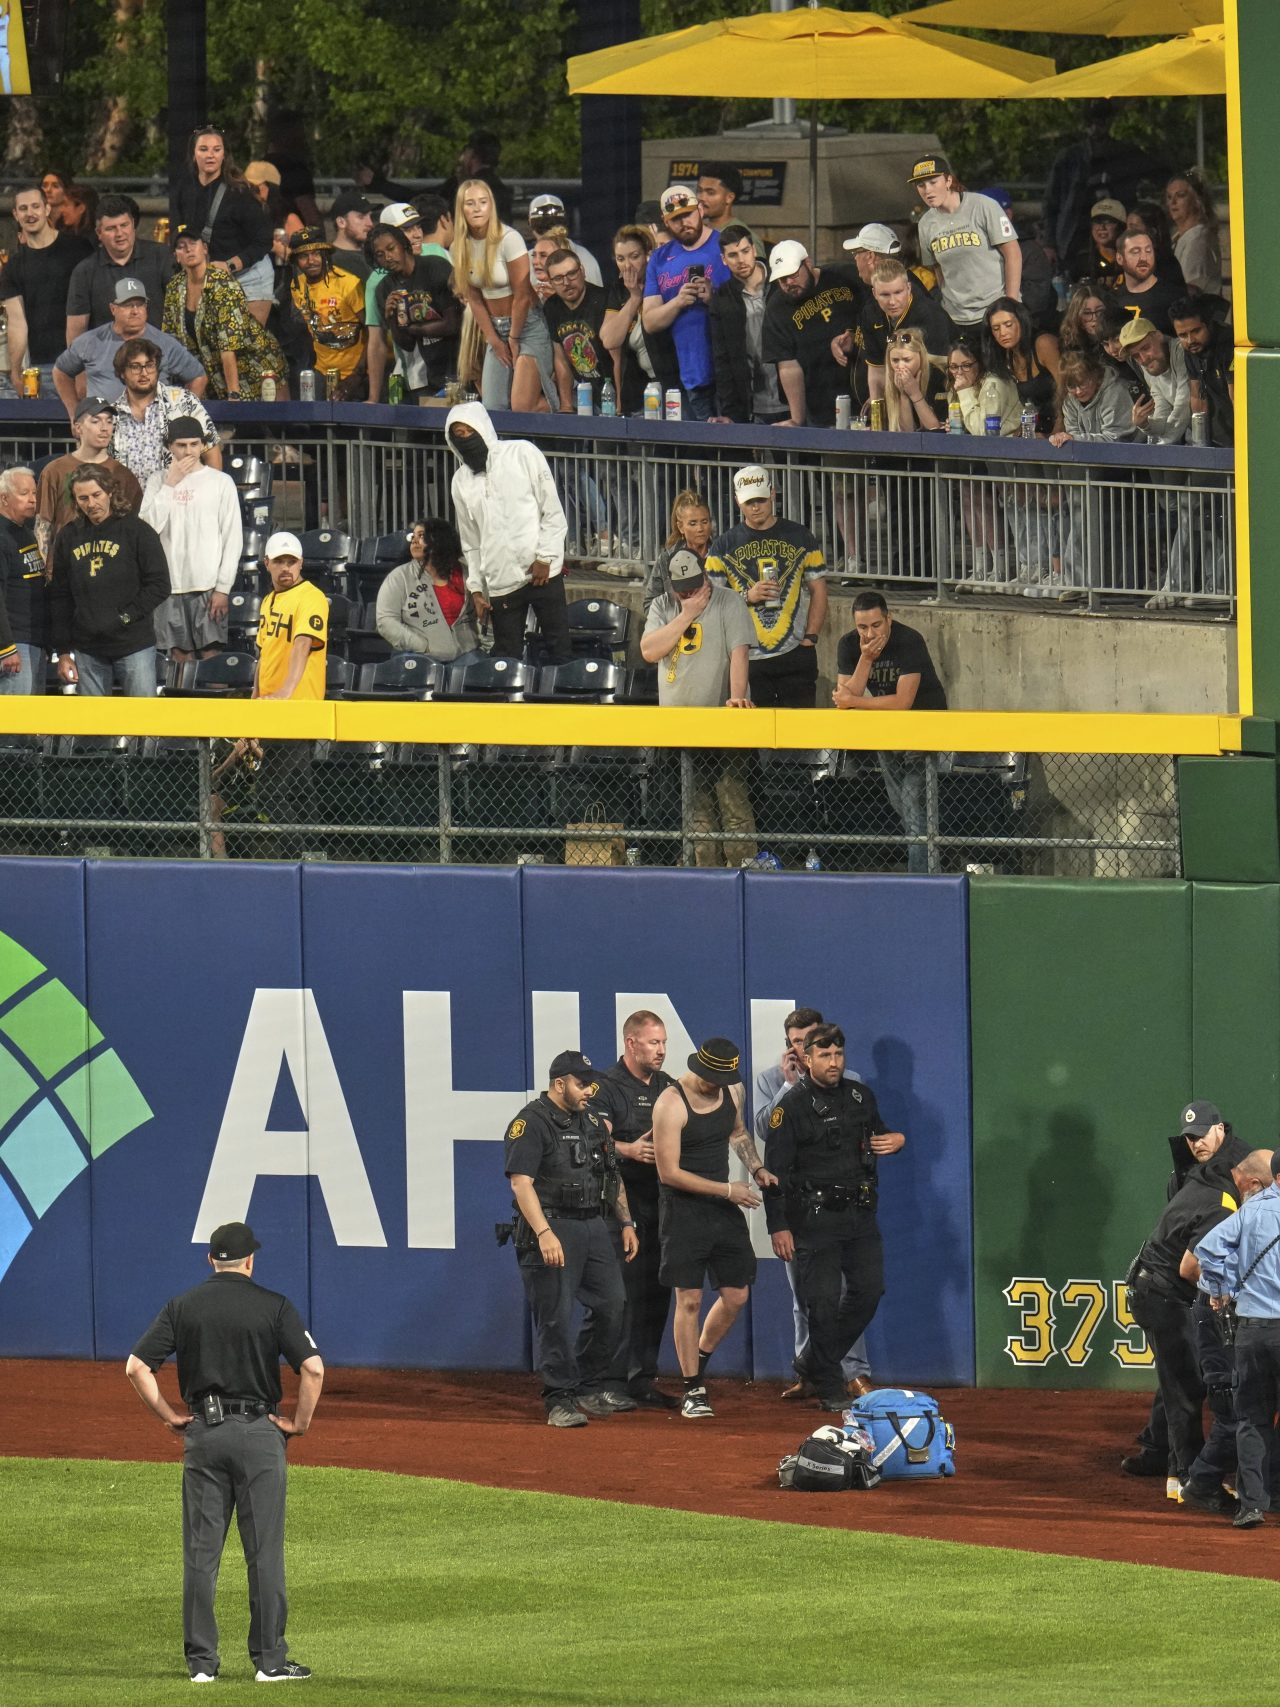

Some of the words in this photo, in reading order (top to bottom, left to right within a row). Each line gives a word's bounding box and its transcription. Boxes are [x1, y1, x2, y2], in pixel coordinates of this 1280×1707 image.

[671, 163, 699, 177] 1974
[931, 231, 982, 254] PIRATES
[793, 286, 854, 330] PIRATES
[821, 308, 832, 323] P
[73, 539, 121, 561] PIRATES
[736, 539, 798, 566] PIRATES
[681, 565, 689, 577] P
[312, 616, 321, 628] P
[1001, 1276, 1156, 1369] 375
[812, 1463, 832, 1472] Series
